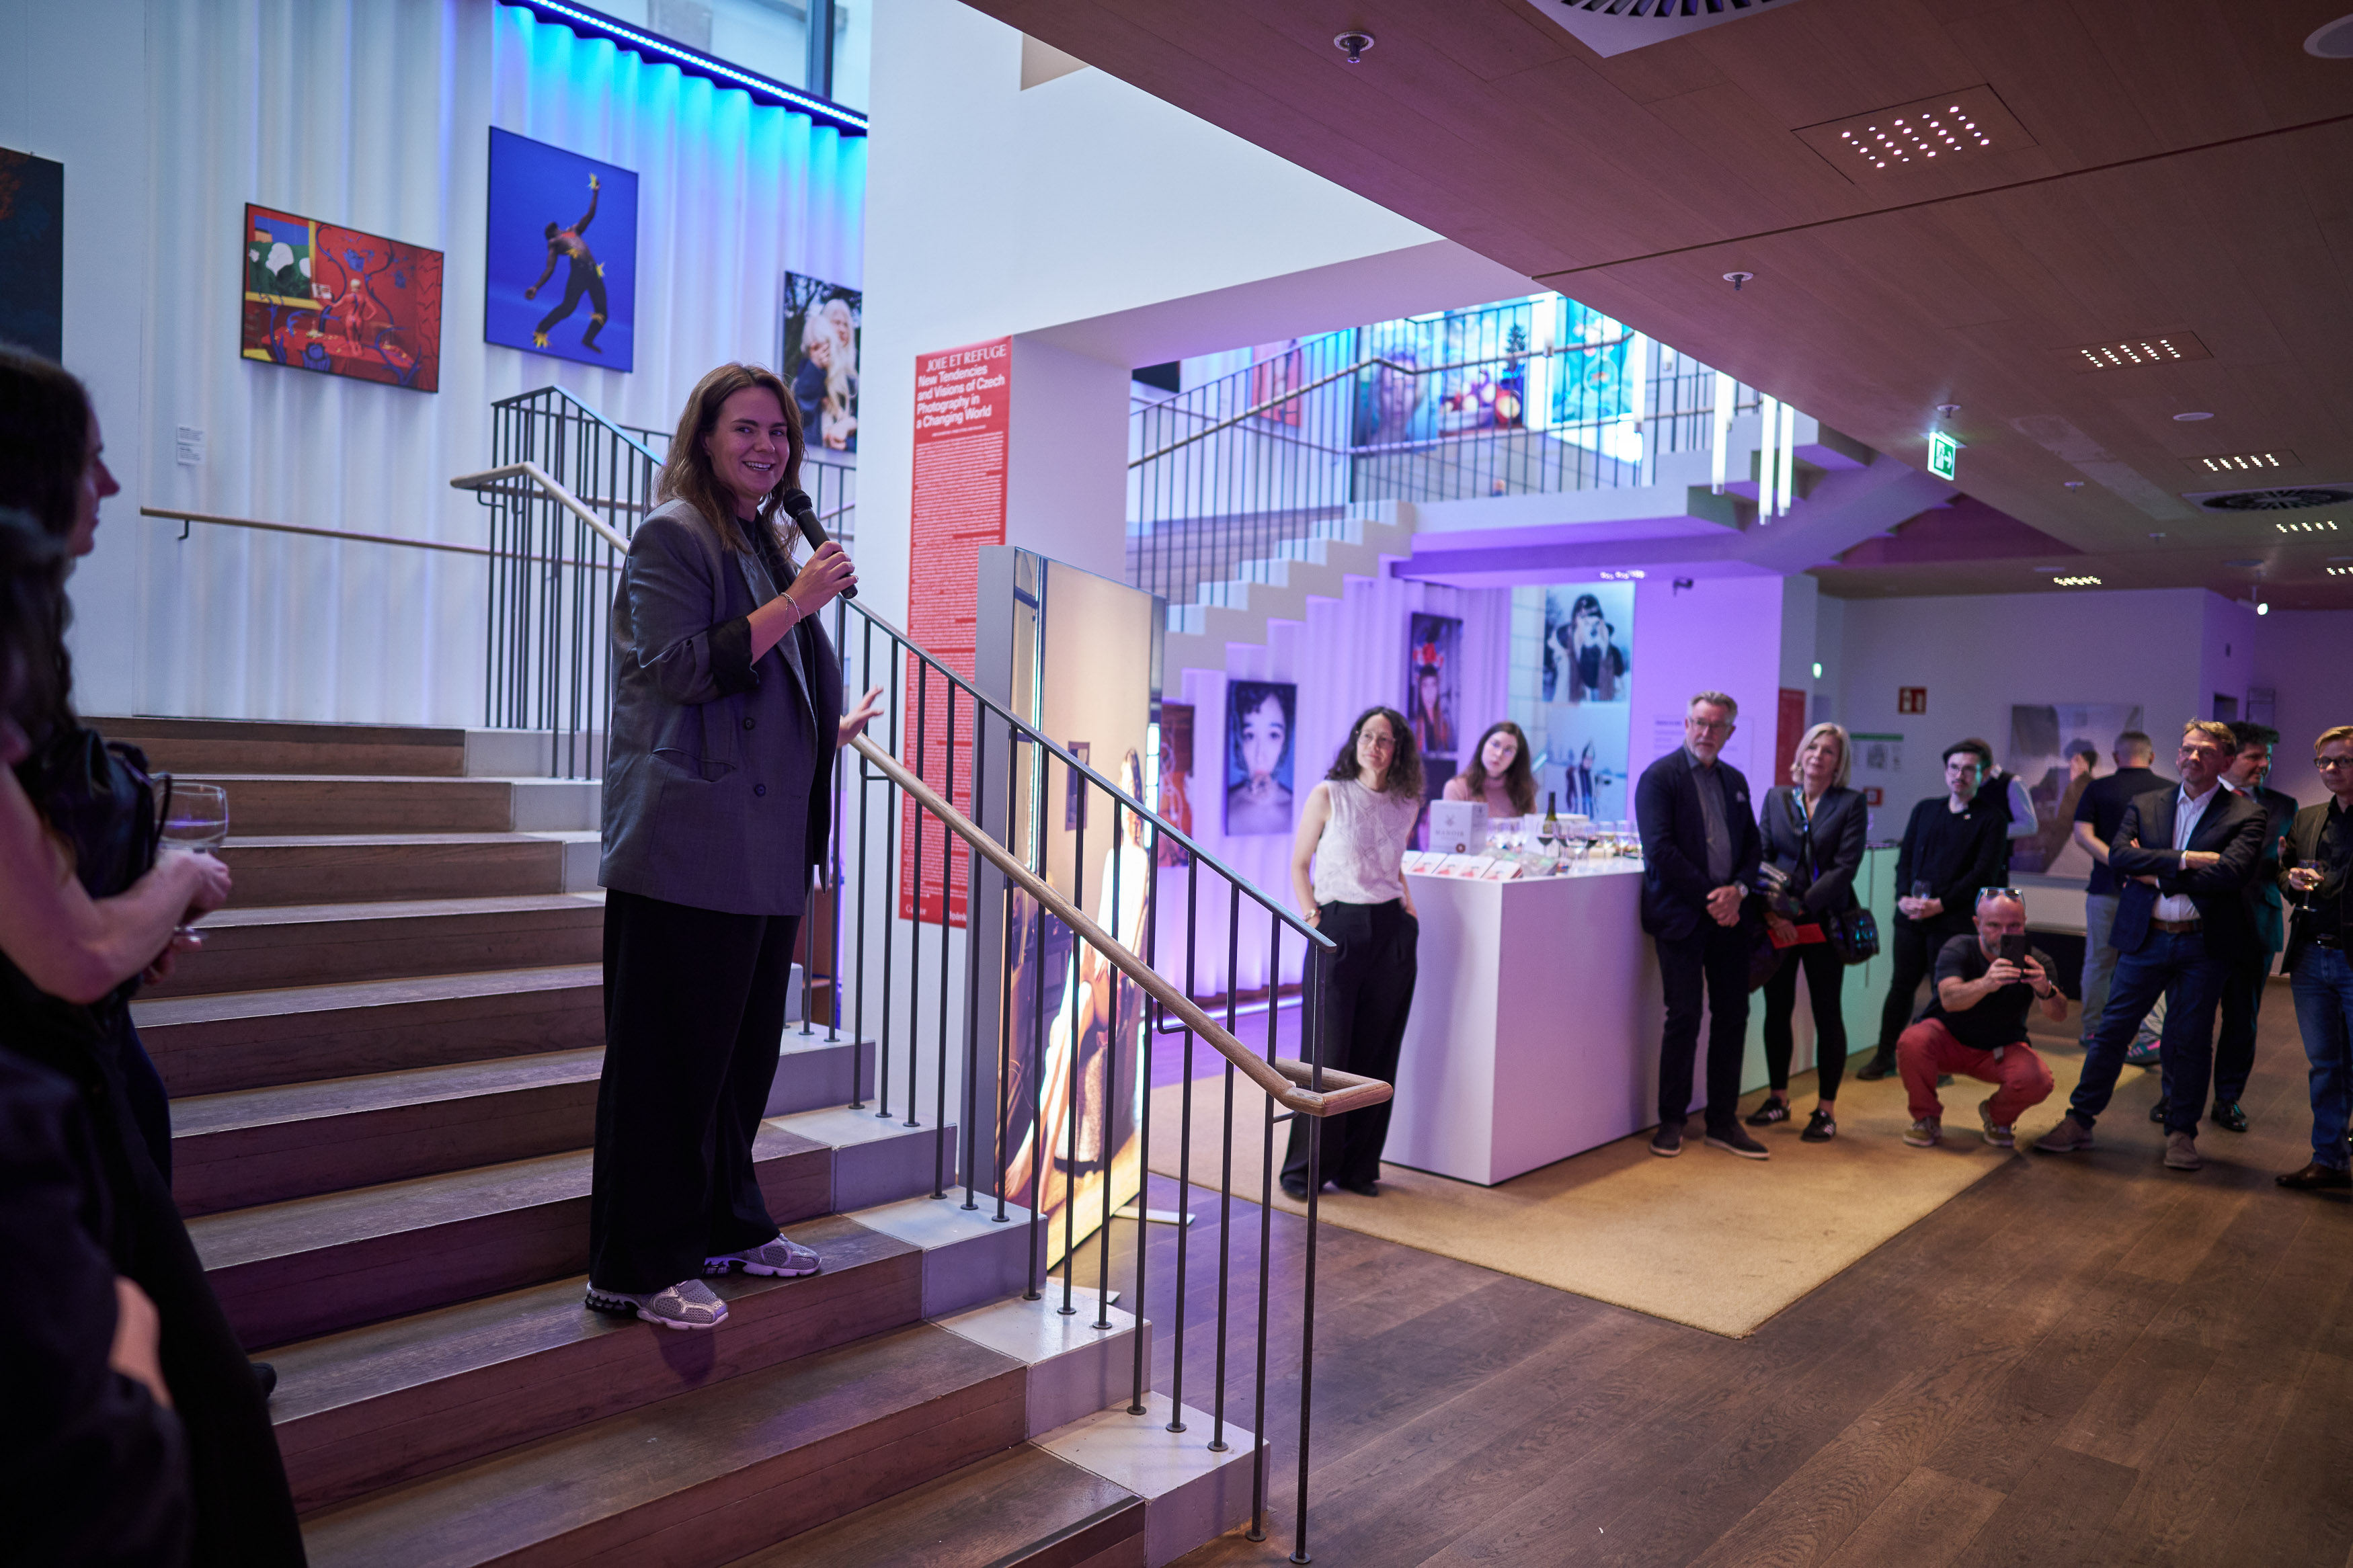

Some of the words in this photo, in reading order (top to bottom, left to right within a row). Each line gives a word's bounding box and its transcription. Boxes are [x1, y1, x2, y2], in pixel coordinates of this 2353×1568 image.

[926, 356, 948, 372] JOIE
[949, 353, 963, 367] ET
[963, 344, 1006, 364] REFUGE
[917, 387, 933, 401] and
[934, 384, 965, 398] Visions
[965, 378, 976, 392] of
[976, 374, 1006, 390] Czech
[918, 375, 938, 388] New
[939, 364, 988, 383] Tendencies
[916, 419, 922, 429] a
[922, 411, 963, 427] Changing
[965, 404, 992, 420] World
[917, 395, 970, 415] Photography
[971, 393, 980, 405] in
